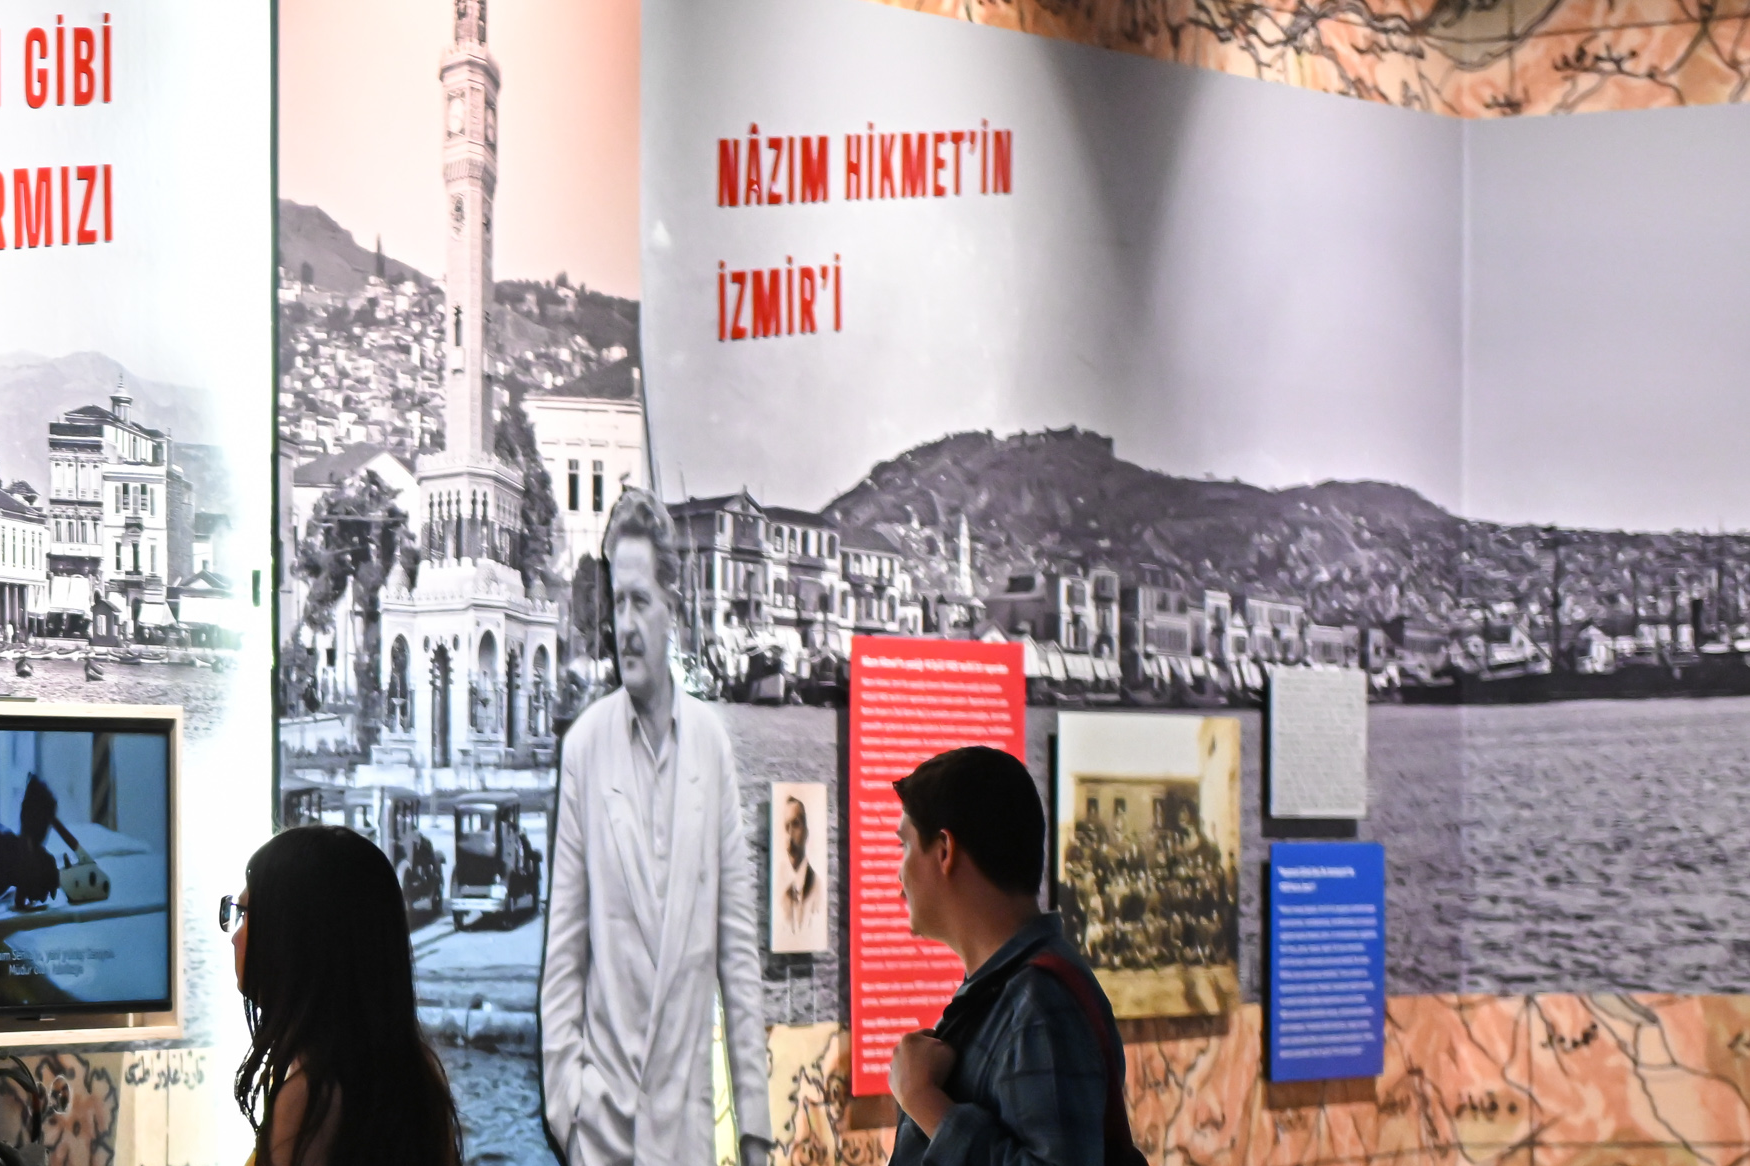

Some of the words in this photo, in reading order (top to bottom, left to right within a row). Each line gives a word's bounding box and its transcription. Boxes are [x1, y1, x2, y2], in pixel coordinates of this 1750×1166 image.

[24, 12, 113, 109] GİBİ
[717, 123, 830, 207] NÂZIM
[845, 119, 1012, 200] HİKMET'İN
[717, 252, 842, 341] İZMİR'İ
